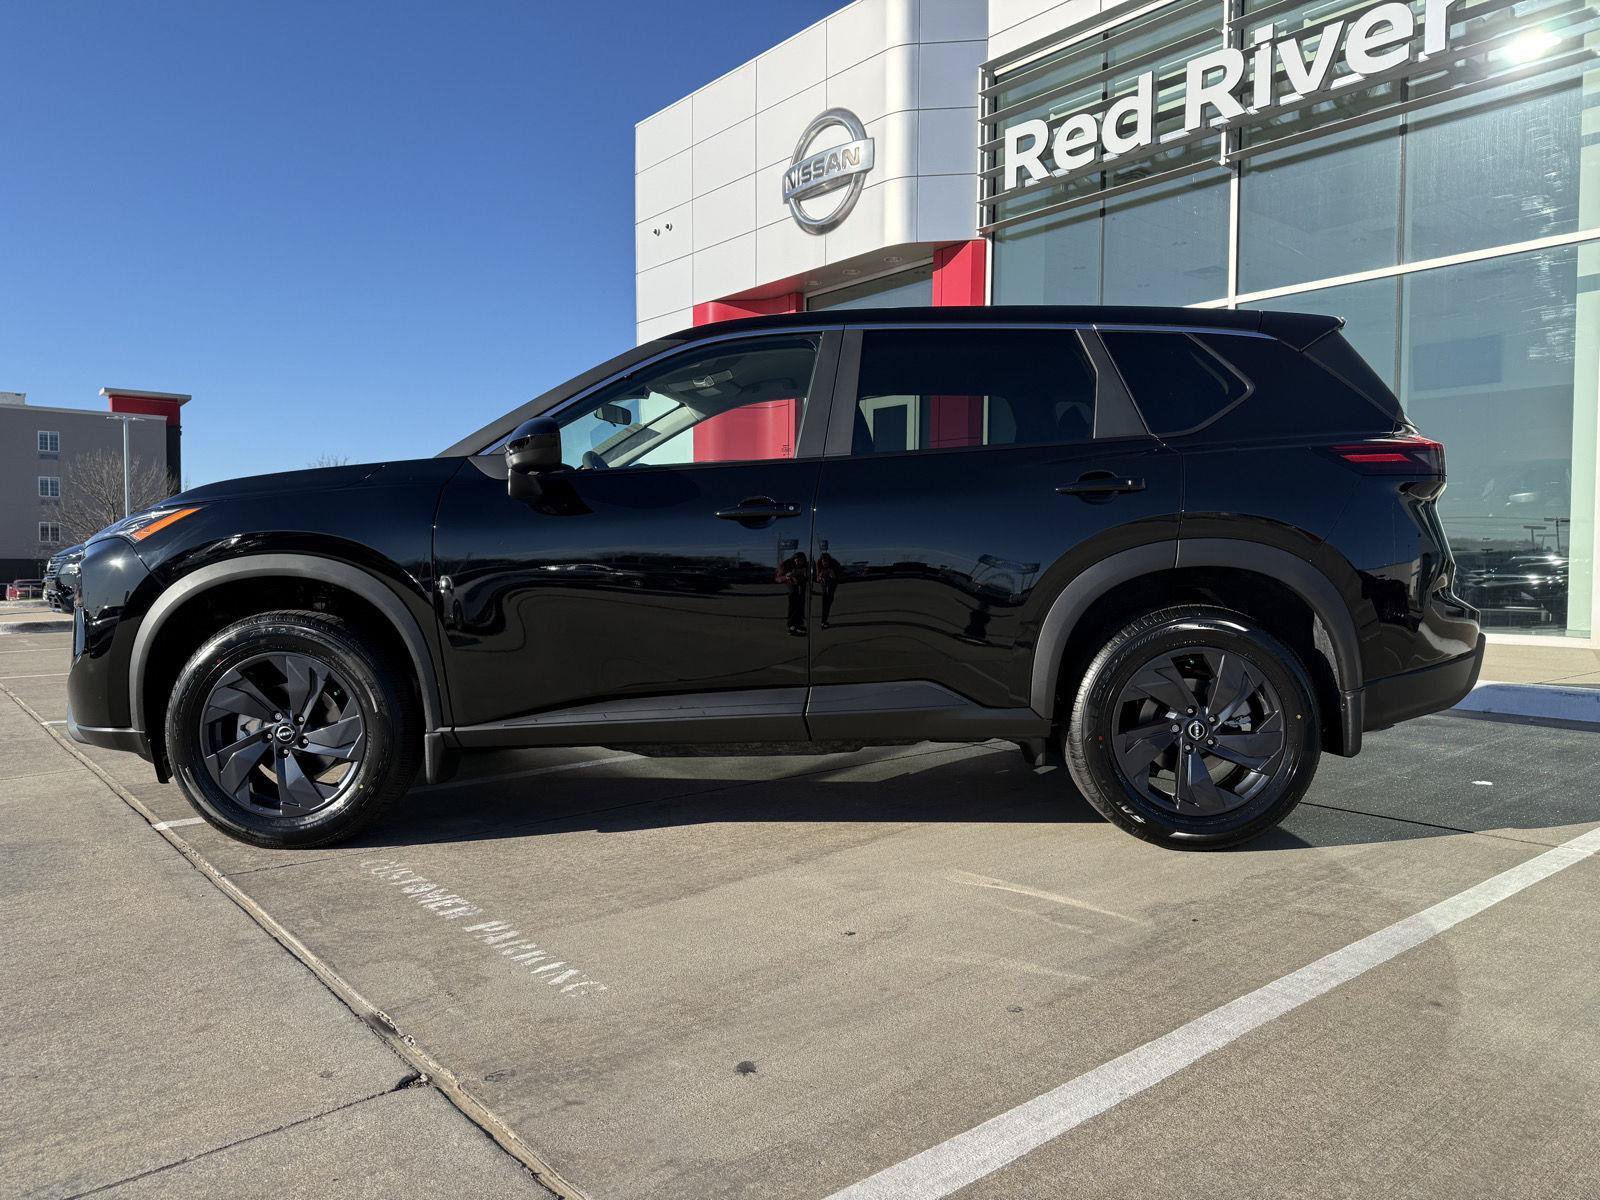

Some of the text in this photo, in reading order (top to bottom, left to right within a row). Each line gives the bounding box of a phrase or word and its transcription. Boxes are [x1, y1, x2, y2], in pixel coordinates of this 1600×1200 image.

[1003, 0, 1456, 192] Red River
[785, 146, 861, 194] NISSAN
[360, 859, 484, 919] CUSTOMER
